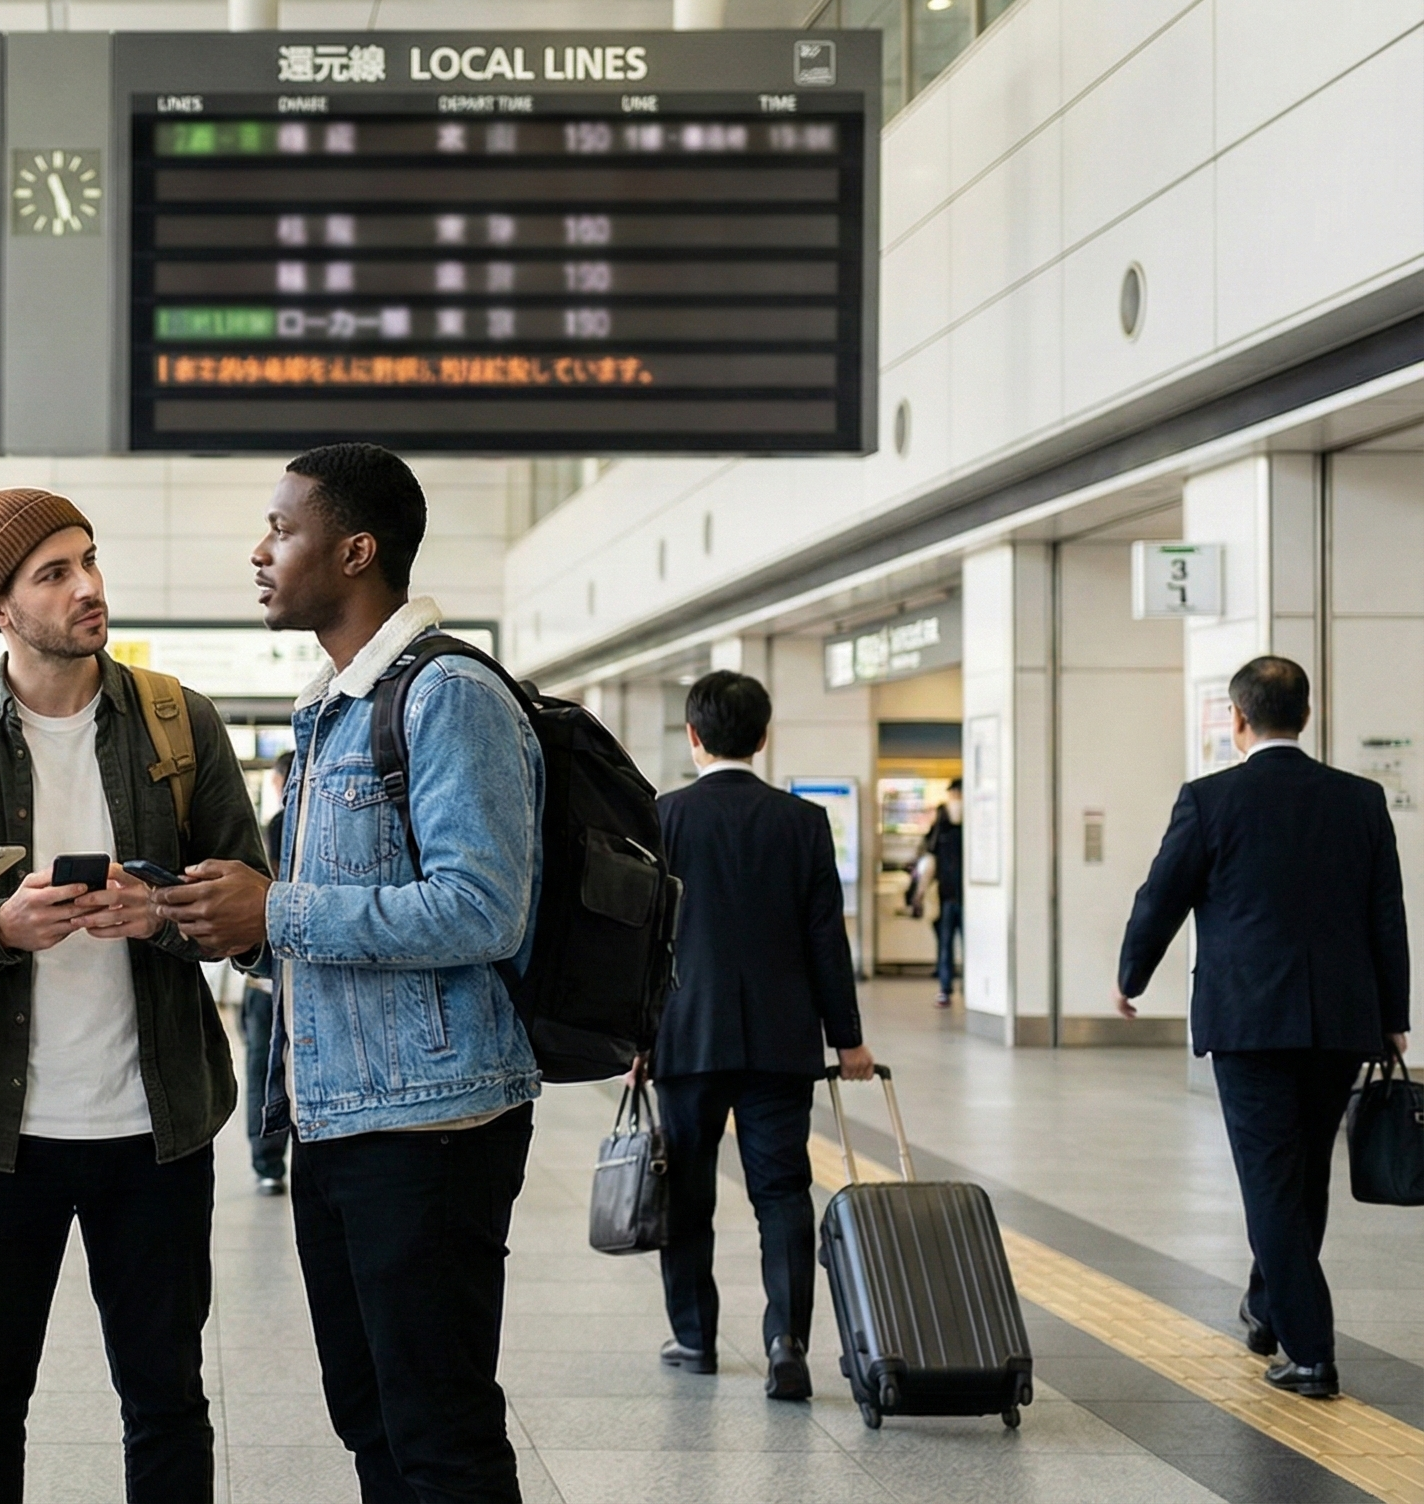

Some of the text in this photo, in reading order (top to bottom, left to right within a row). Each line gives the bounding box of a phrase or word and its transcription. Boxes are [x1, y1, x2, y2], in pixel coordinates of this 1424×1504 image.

[410, 47, 535, 81] LOCAL
[545, 47, 648, 81] LINES
[759, 95, 797, 112] TIME
[1171, 559, 1187, 581] 3
